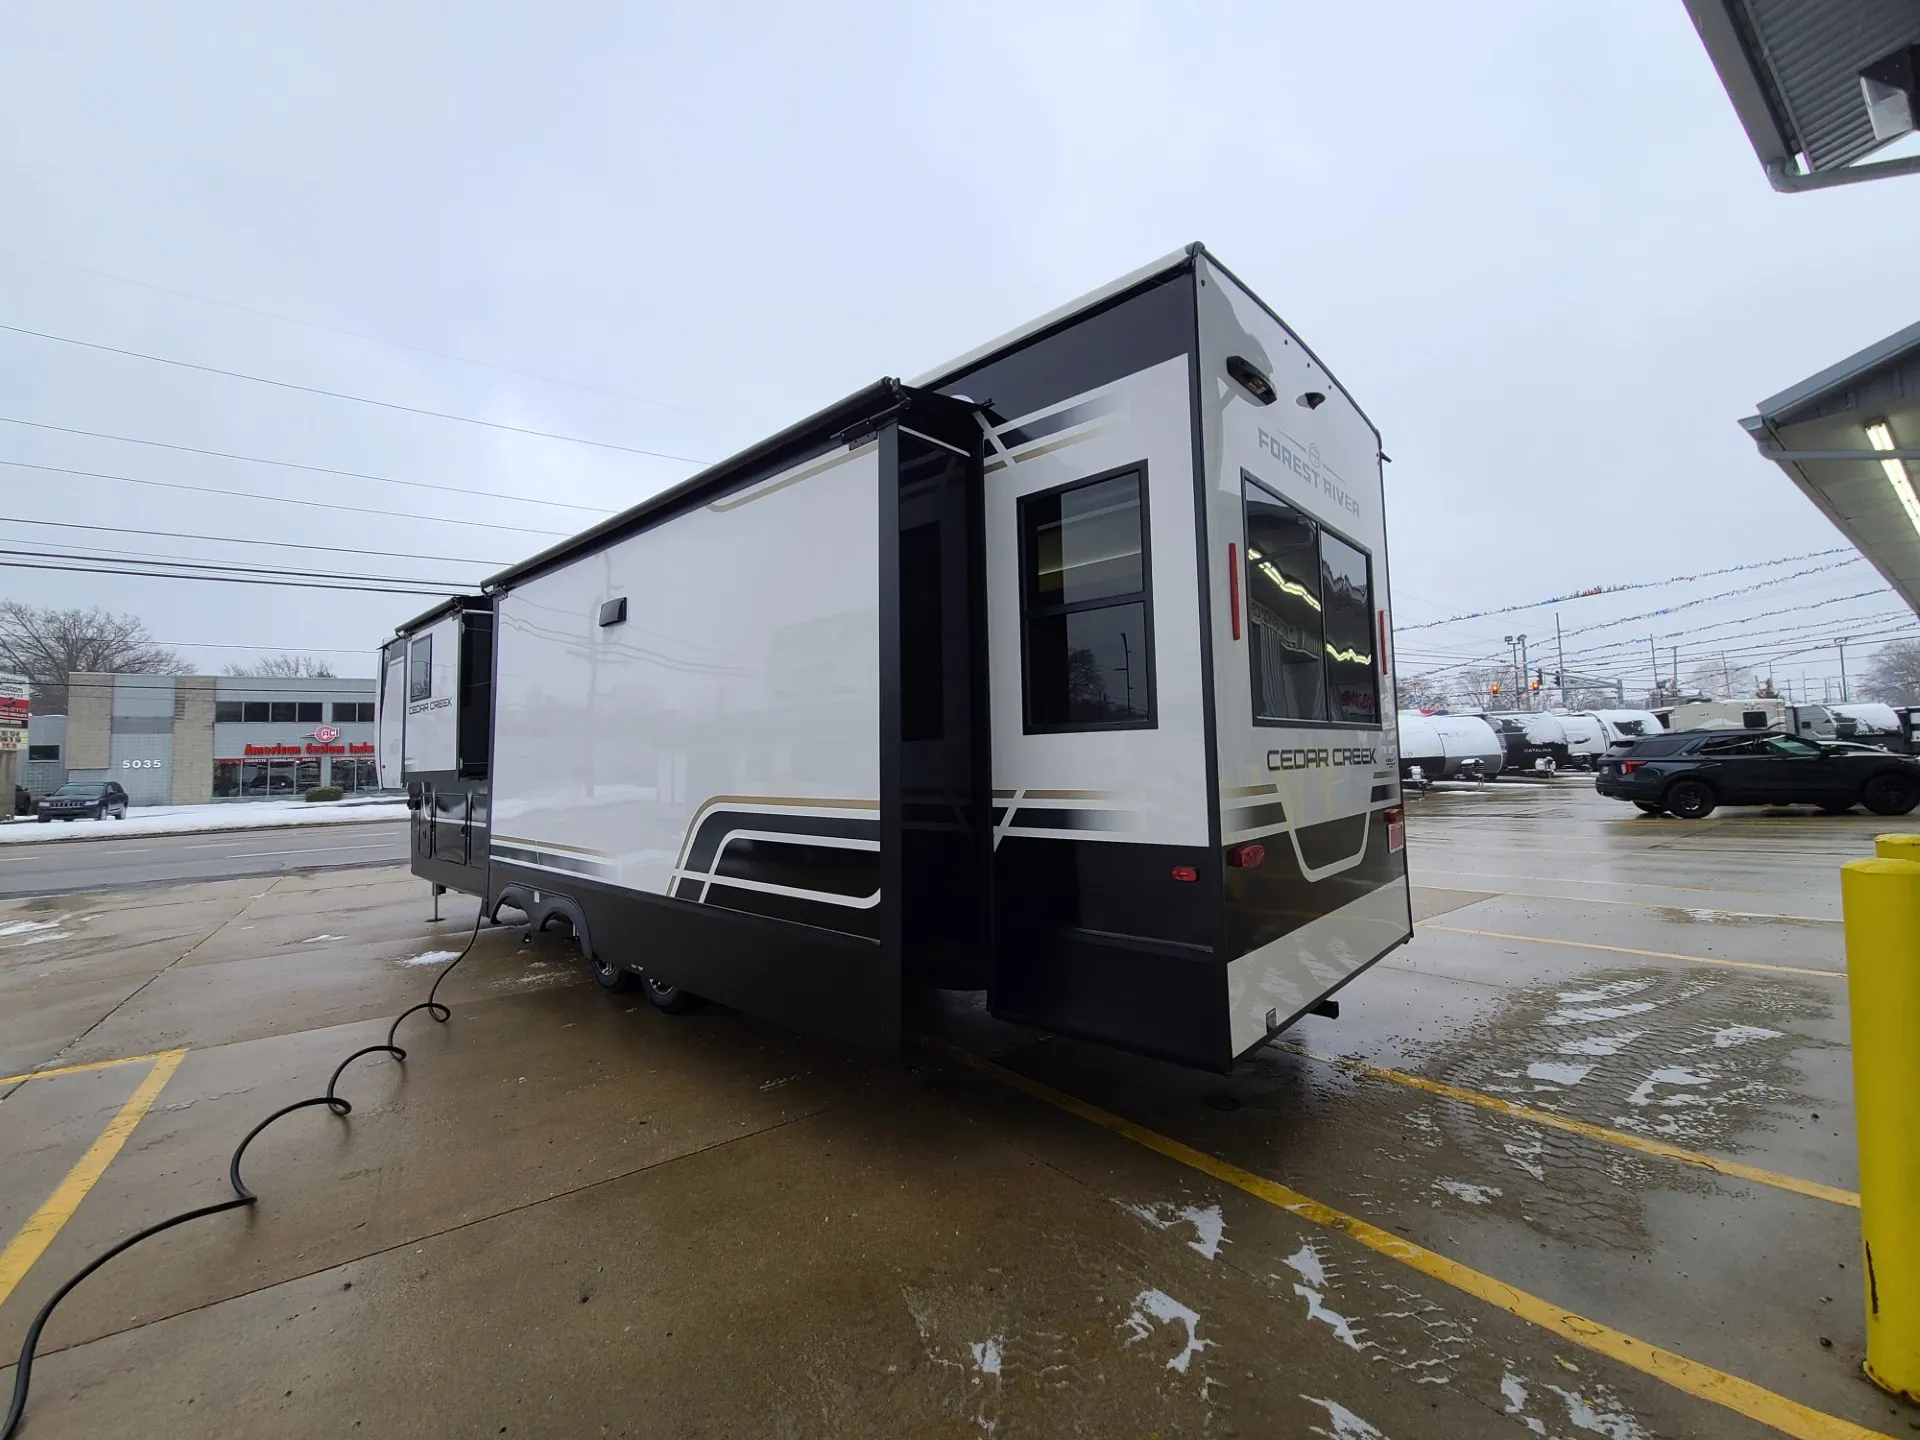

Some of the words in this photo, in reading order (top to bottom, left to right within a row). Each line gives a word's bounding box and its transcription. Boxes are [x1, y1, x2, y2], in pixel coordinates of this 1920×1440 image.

[1257, 427, 1320, 488] FOREST
[1323, 477, 1360, 518] RIVER
[408, 702, 429, 715] CEDAR
[430, 697, 452, 710] CREEK
[322, 727, 339, 738] ACI
[244, 742, 301, 755] American
[305, 742, 345, 754] Custom
[122, 759, 161, 769] 5035
[1267, 748, 1330, 772] CEDAR
[1332, 747, 1377, 767] CREEK
